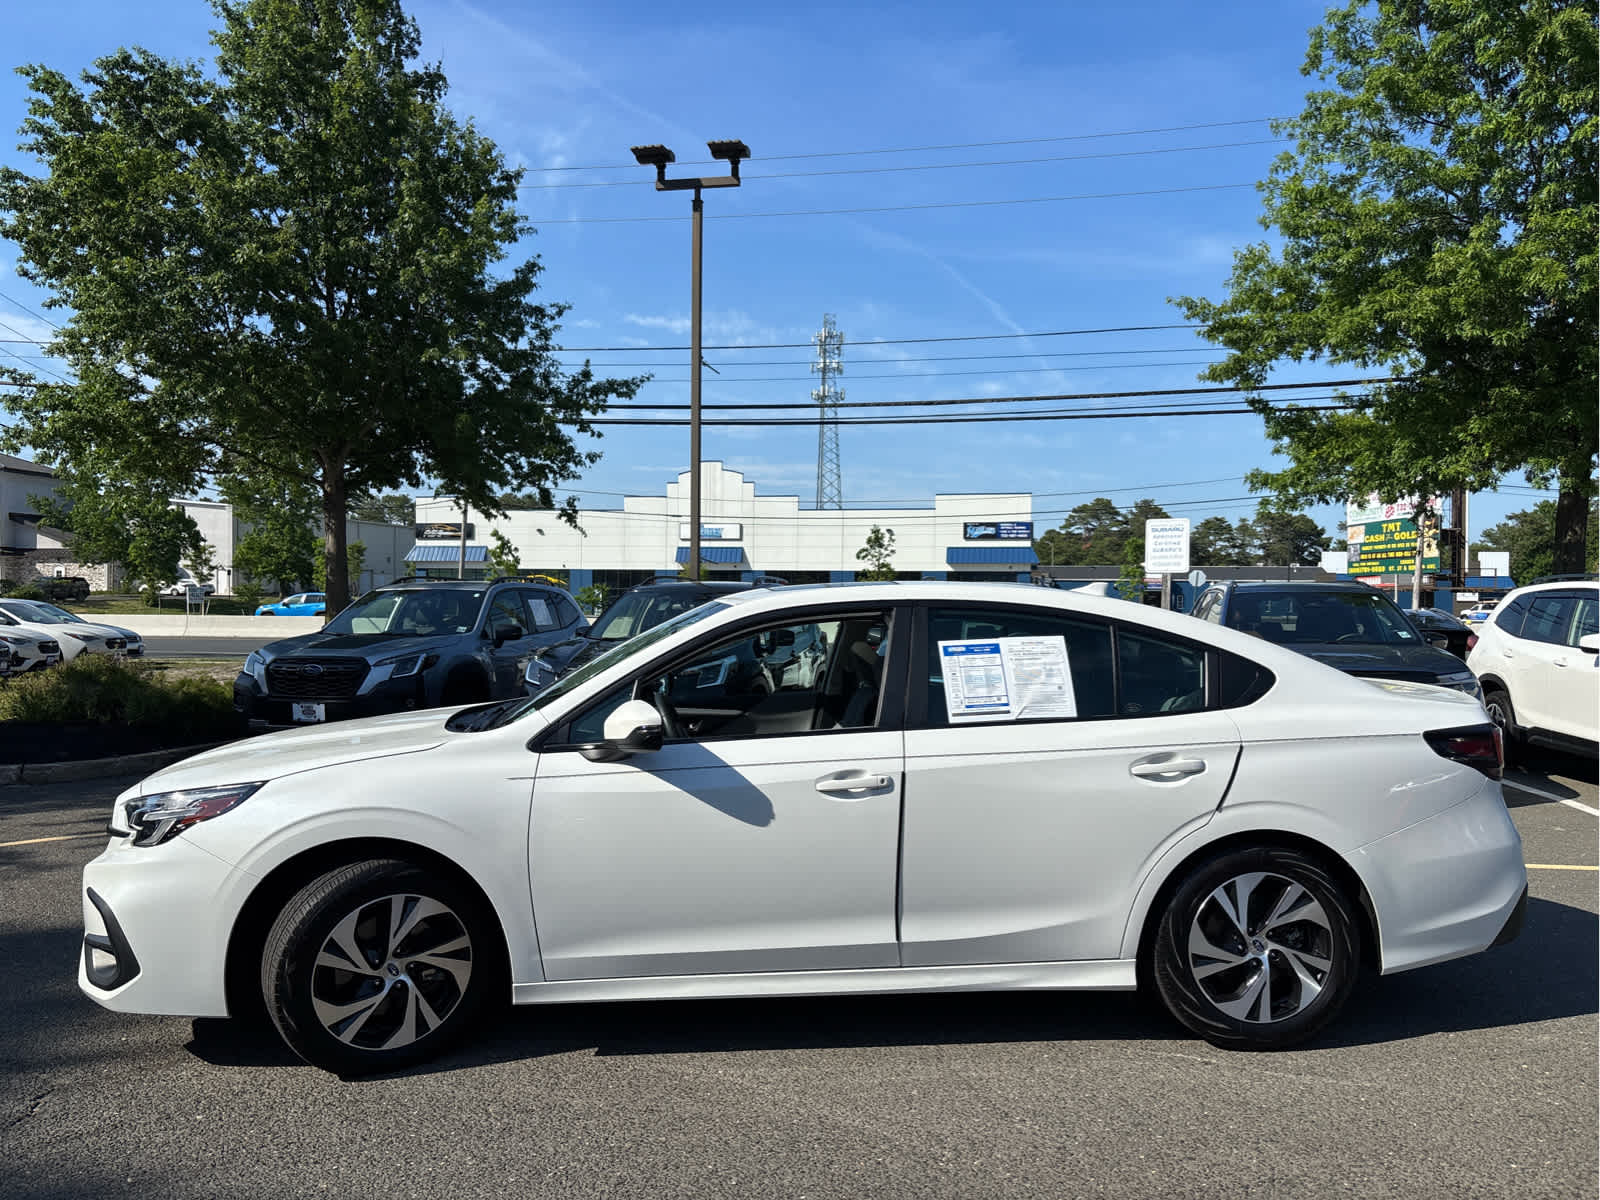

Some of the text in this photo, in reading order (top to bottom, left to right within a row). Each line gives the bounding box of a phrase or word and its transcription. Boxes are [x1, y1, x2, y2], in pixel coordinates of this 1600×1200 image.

[1382, 522, 1402, 532] TMT
[1365, 534, 1385, 543] CASH
[1394, 531, 1418, 541] GOLD
